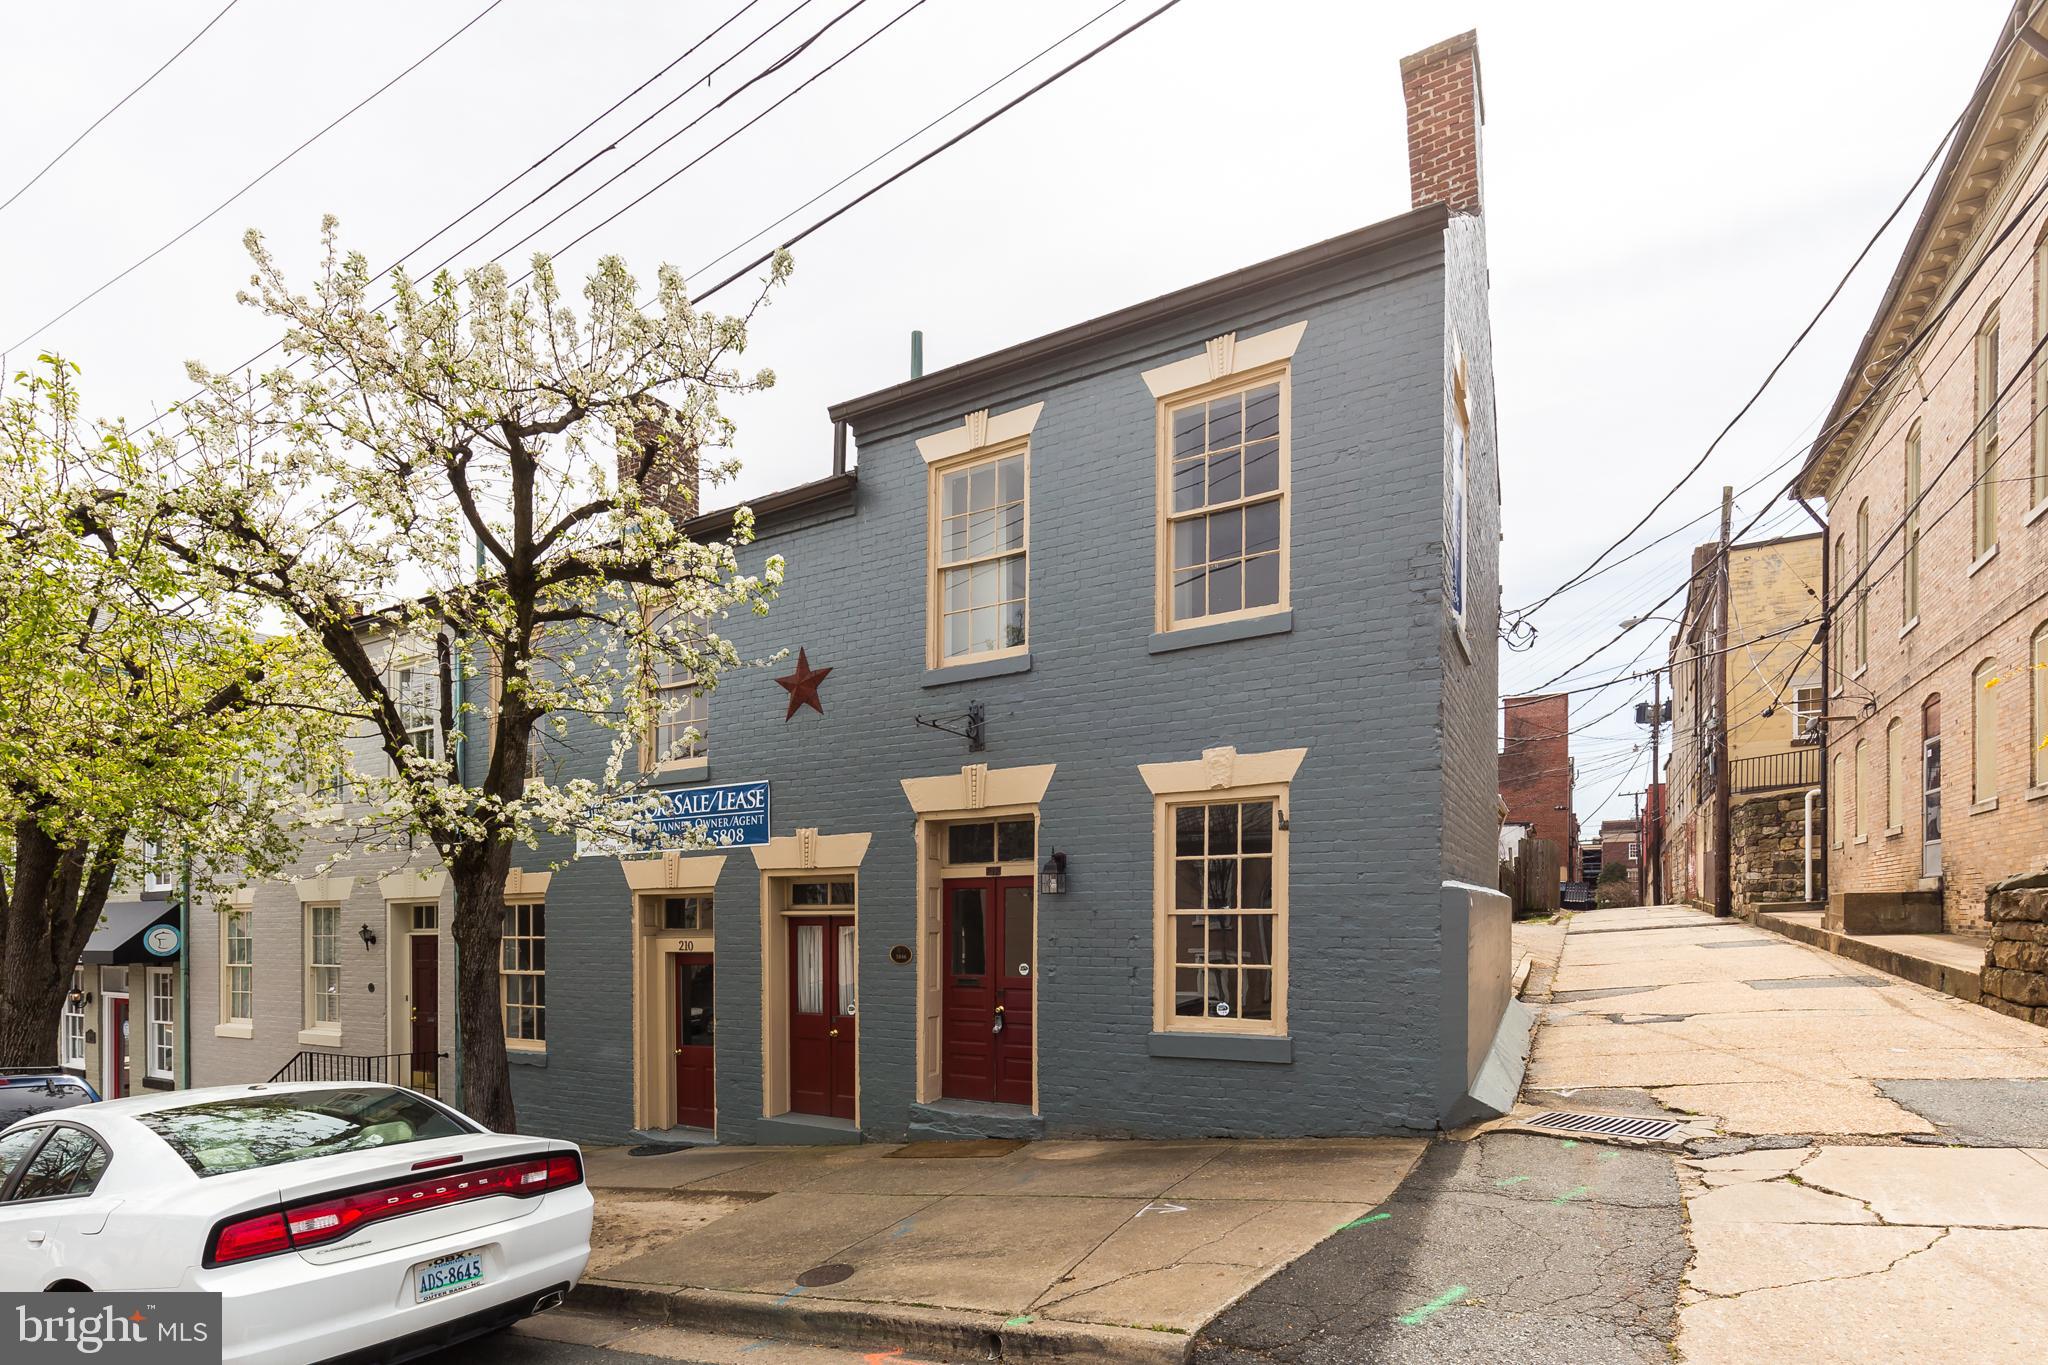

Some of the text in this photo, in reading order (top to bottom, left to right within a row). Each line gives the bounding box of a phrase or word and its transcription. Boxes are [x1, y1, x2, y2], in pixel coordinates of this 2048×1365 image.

[674, 789, 765, 816] SALE/LEASE
[695, 814, 765, 829] OWNER/AGENT
[678, 940, 694, 952] 210
[419, 1260, 481, 1293] ADS-8645
